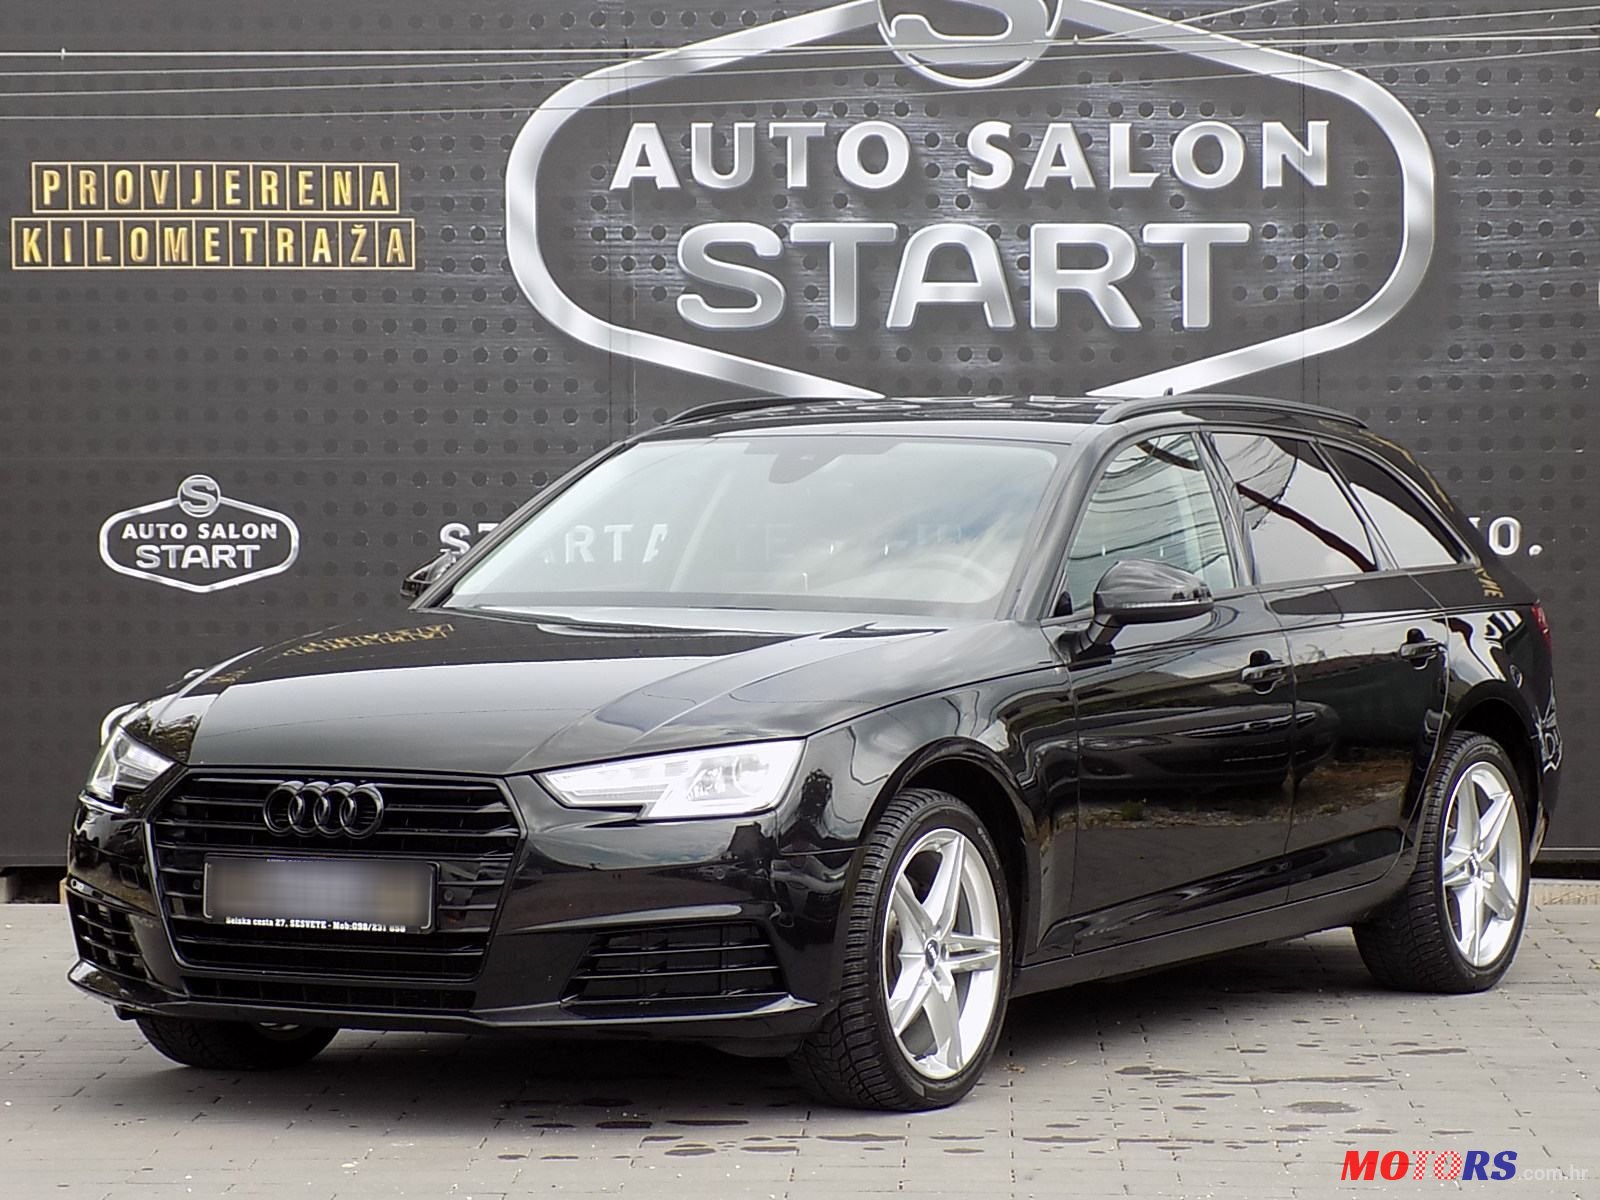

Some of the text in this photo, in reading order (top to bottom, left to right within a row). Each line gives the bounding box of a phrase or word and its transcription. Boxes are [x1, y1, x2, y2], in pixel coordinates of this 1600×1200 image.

[608, 118, 1330, 191] AUTO SALON
[42, 169, 391, 207] PROVJERENA
[22, 223, 407, 264] KILOMETRAŽA
[675, 221, 1252, 330] START
[121, 522, 278, 540] AUTO SALON
[135, 544, 261, 569] START
[289, 918, 327, 930] SESVETE
